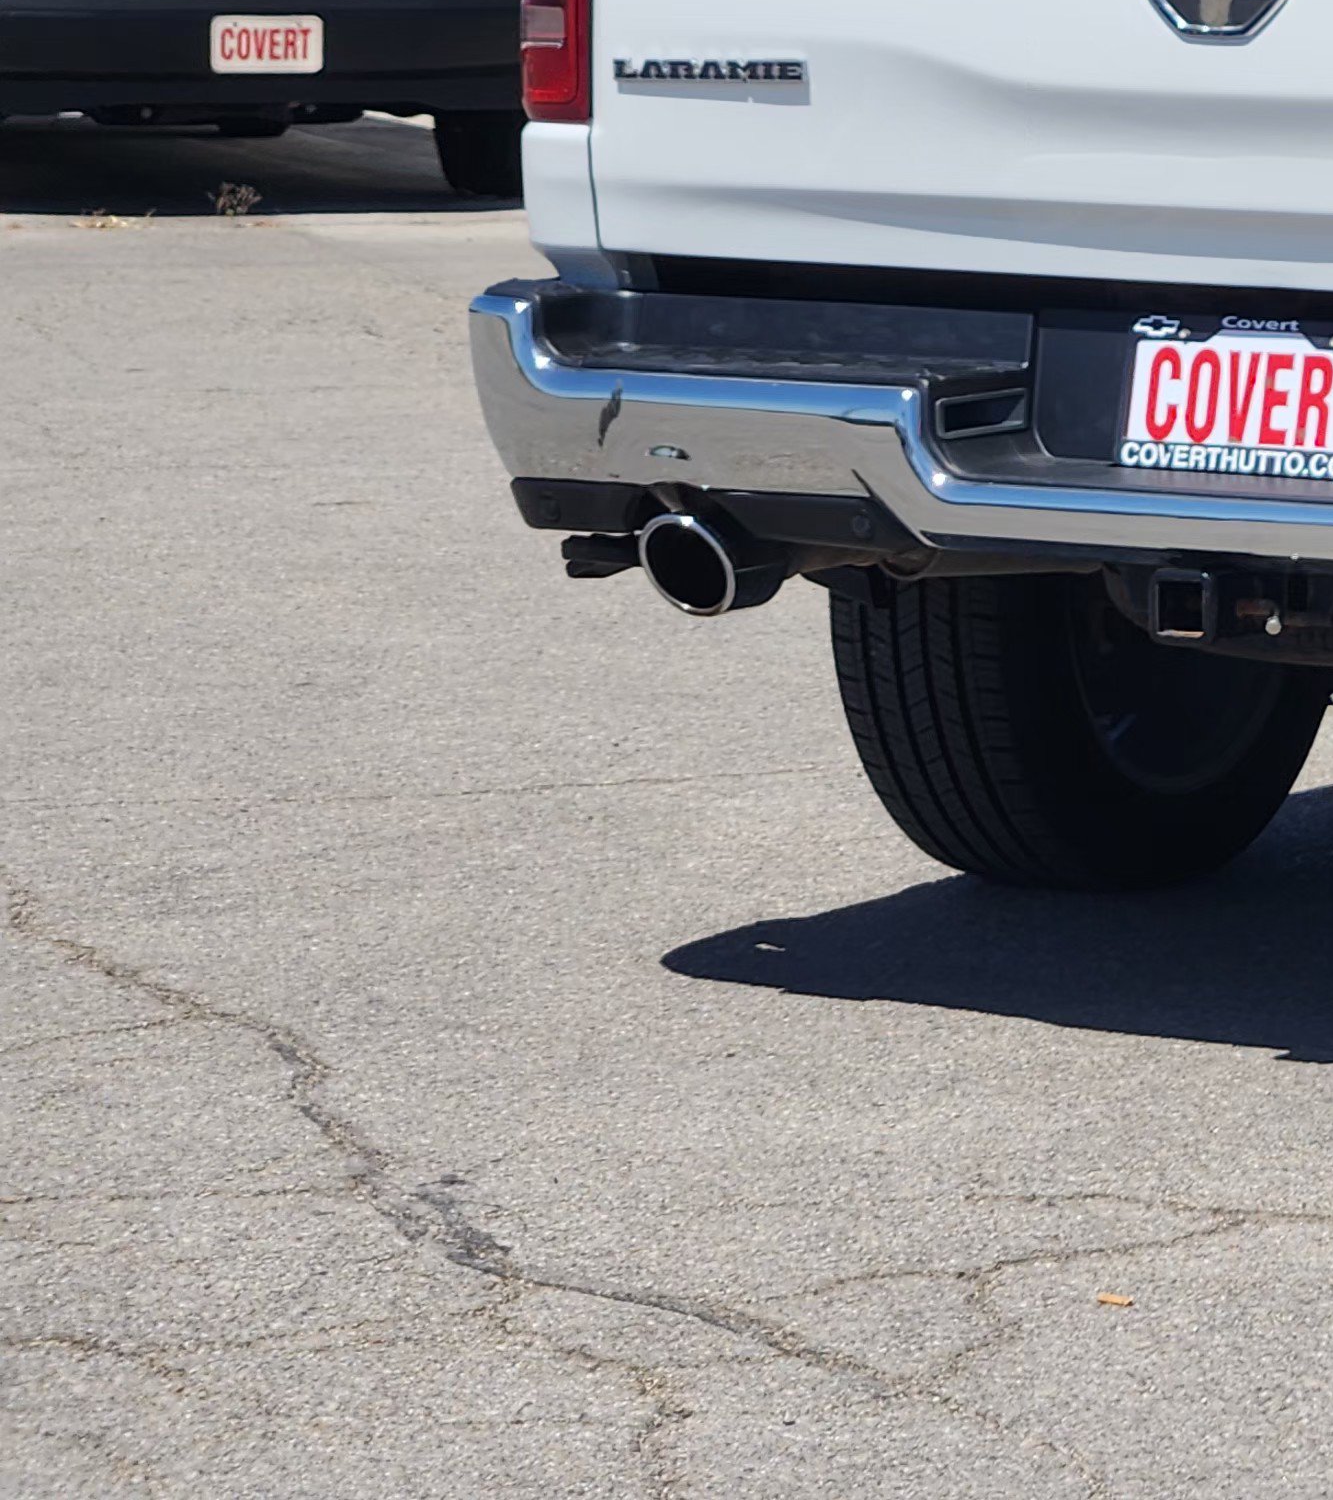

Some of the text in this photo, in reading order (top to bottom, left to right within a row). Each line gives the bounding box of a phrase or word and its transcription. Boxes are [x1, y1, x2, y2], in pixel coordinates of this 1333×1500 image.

[220, 27, 312, 61] COVERT
[613, 58, 806, 82] LARAMIE
[1221, 315, 1300, 332] Covert
